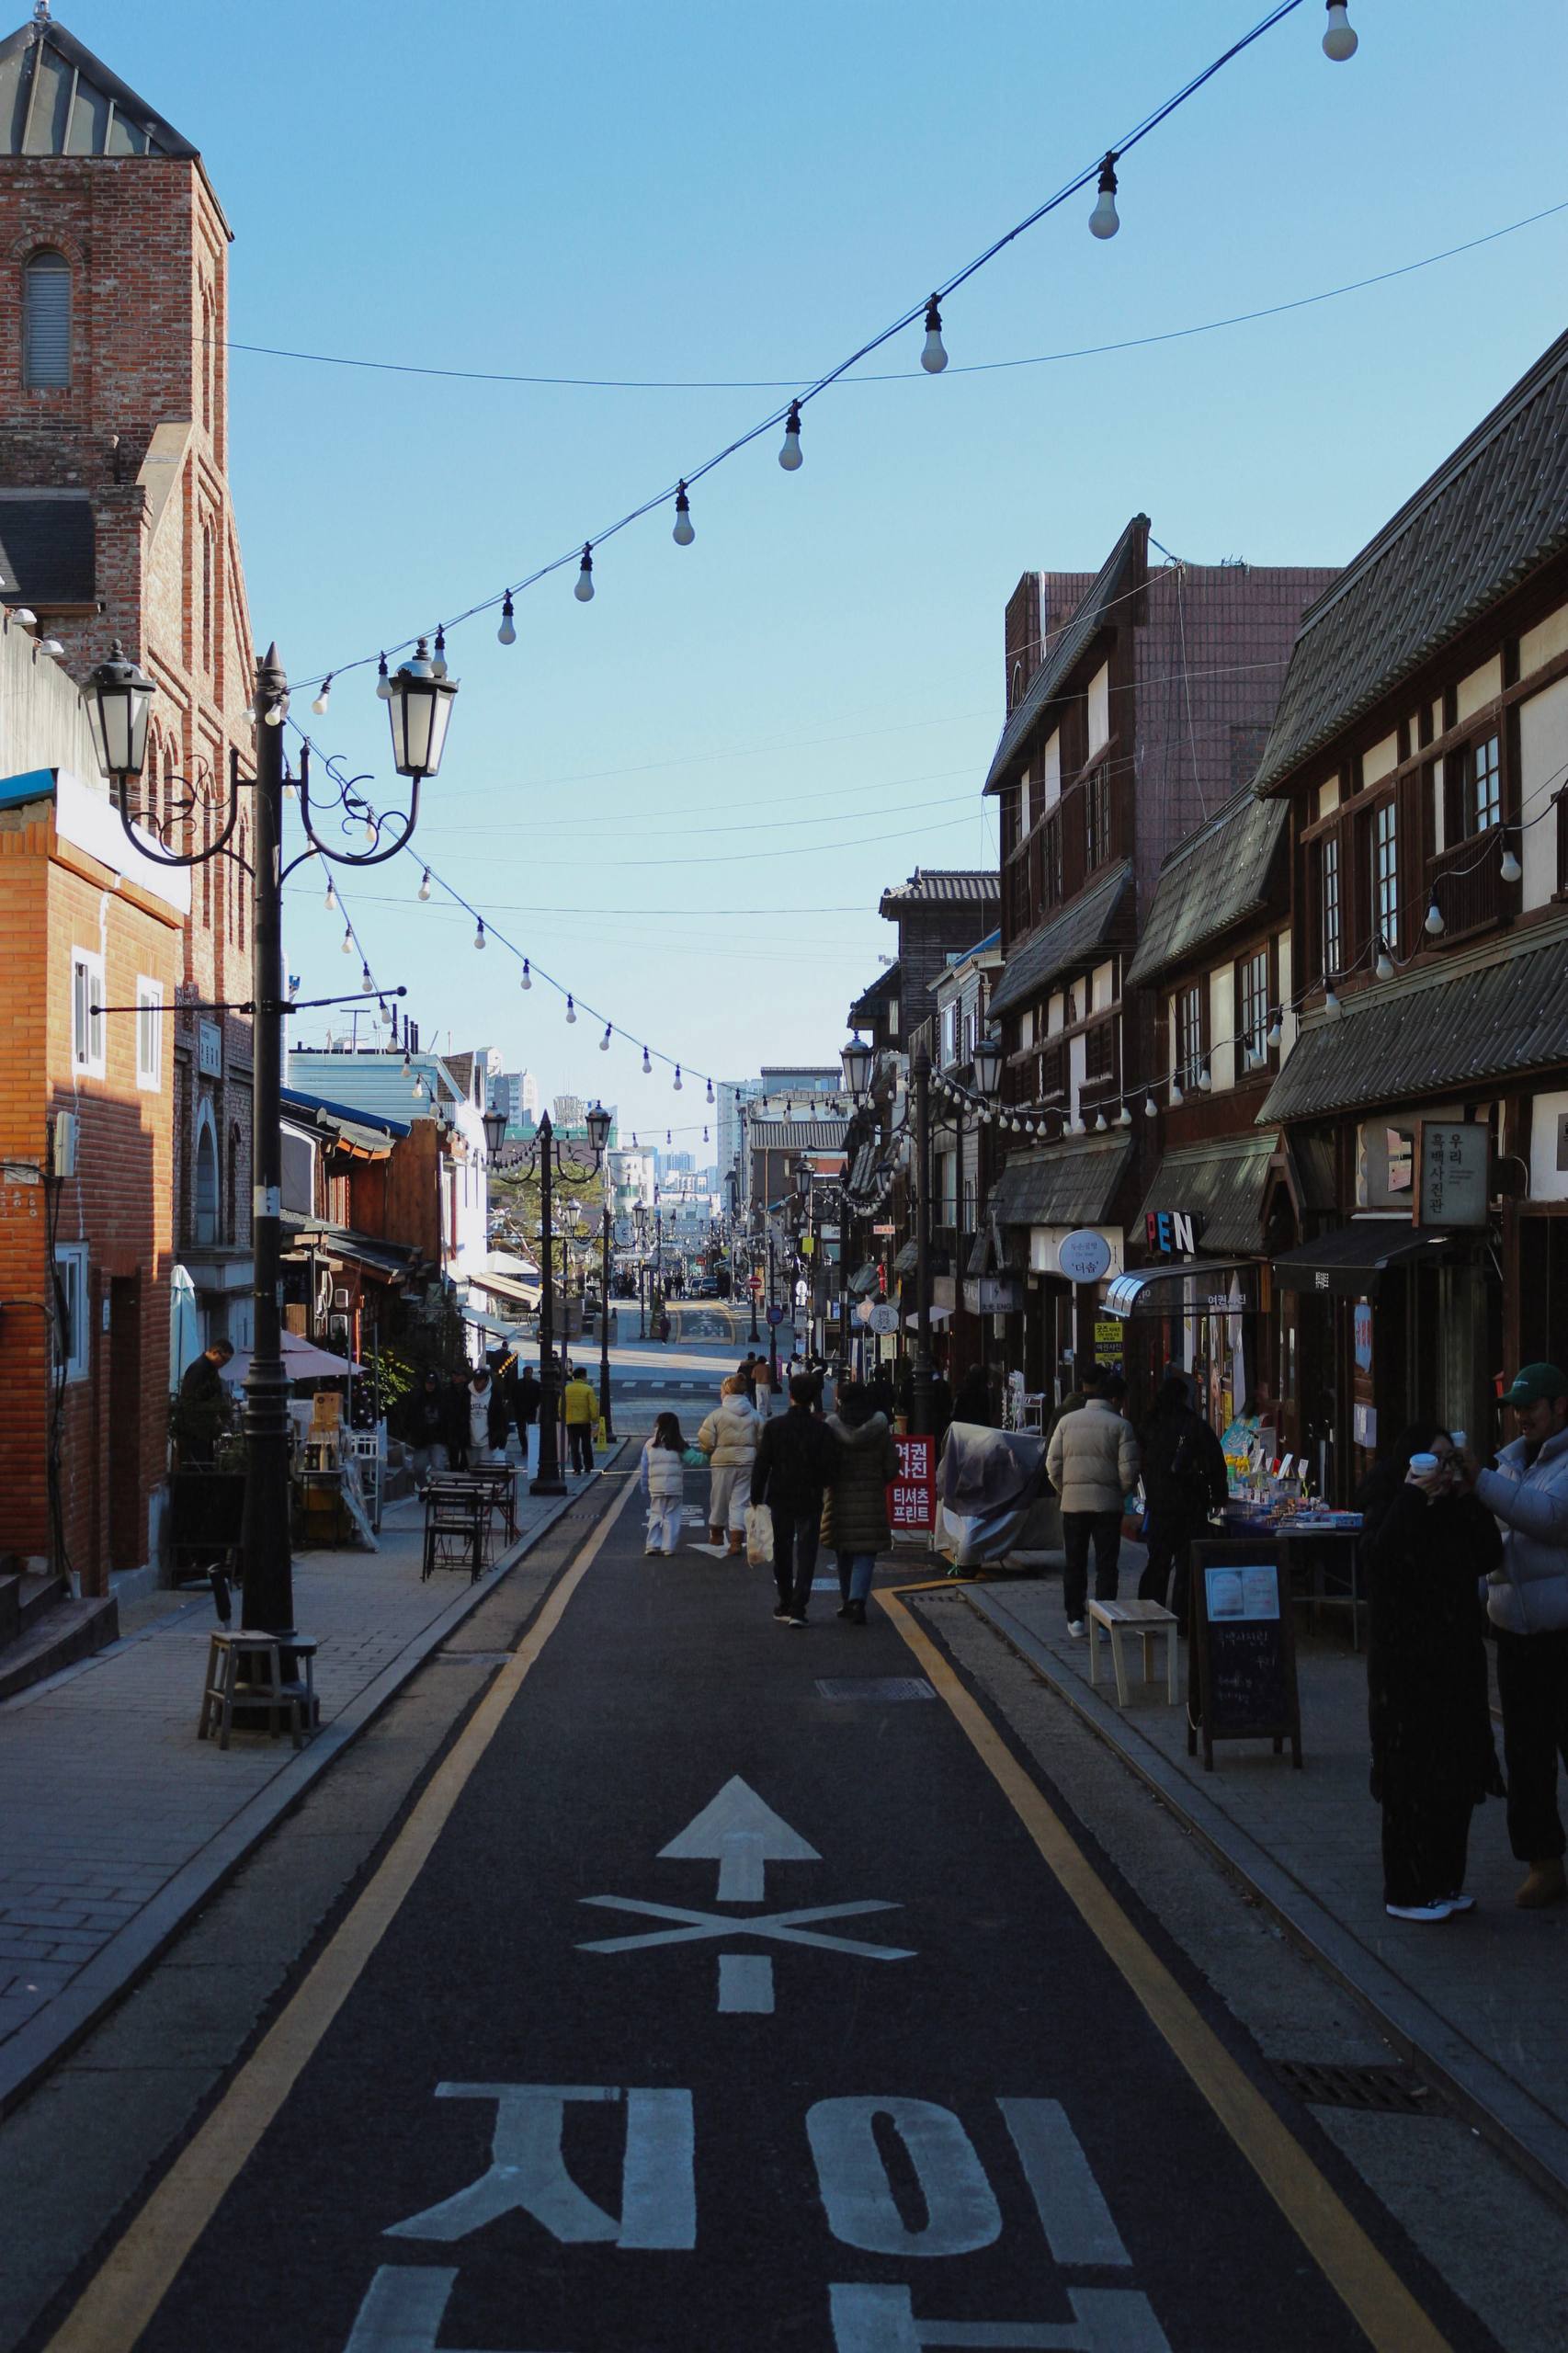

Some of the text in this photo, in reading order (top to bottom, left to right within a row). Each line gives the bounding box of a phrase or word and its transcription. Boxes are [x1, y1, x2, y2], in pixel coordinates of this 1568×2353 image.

[1449, 1133, 1463, 1165] 우리
[1429, 1132, 1445, 1214] 흑백사진관
[1146, 1211, 1195, 1254] PEN
[893, 1486, 929, 1506] 티셔츠
[893, 1506, 929, 1523] 프린트
